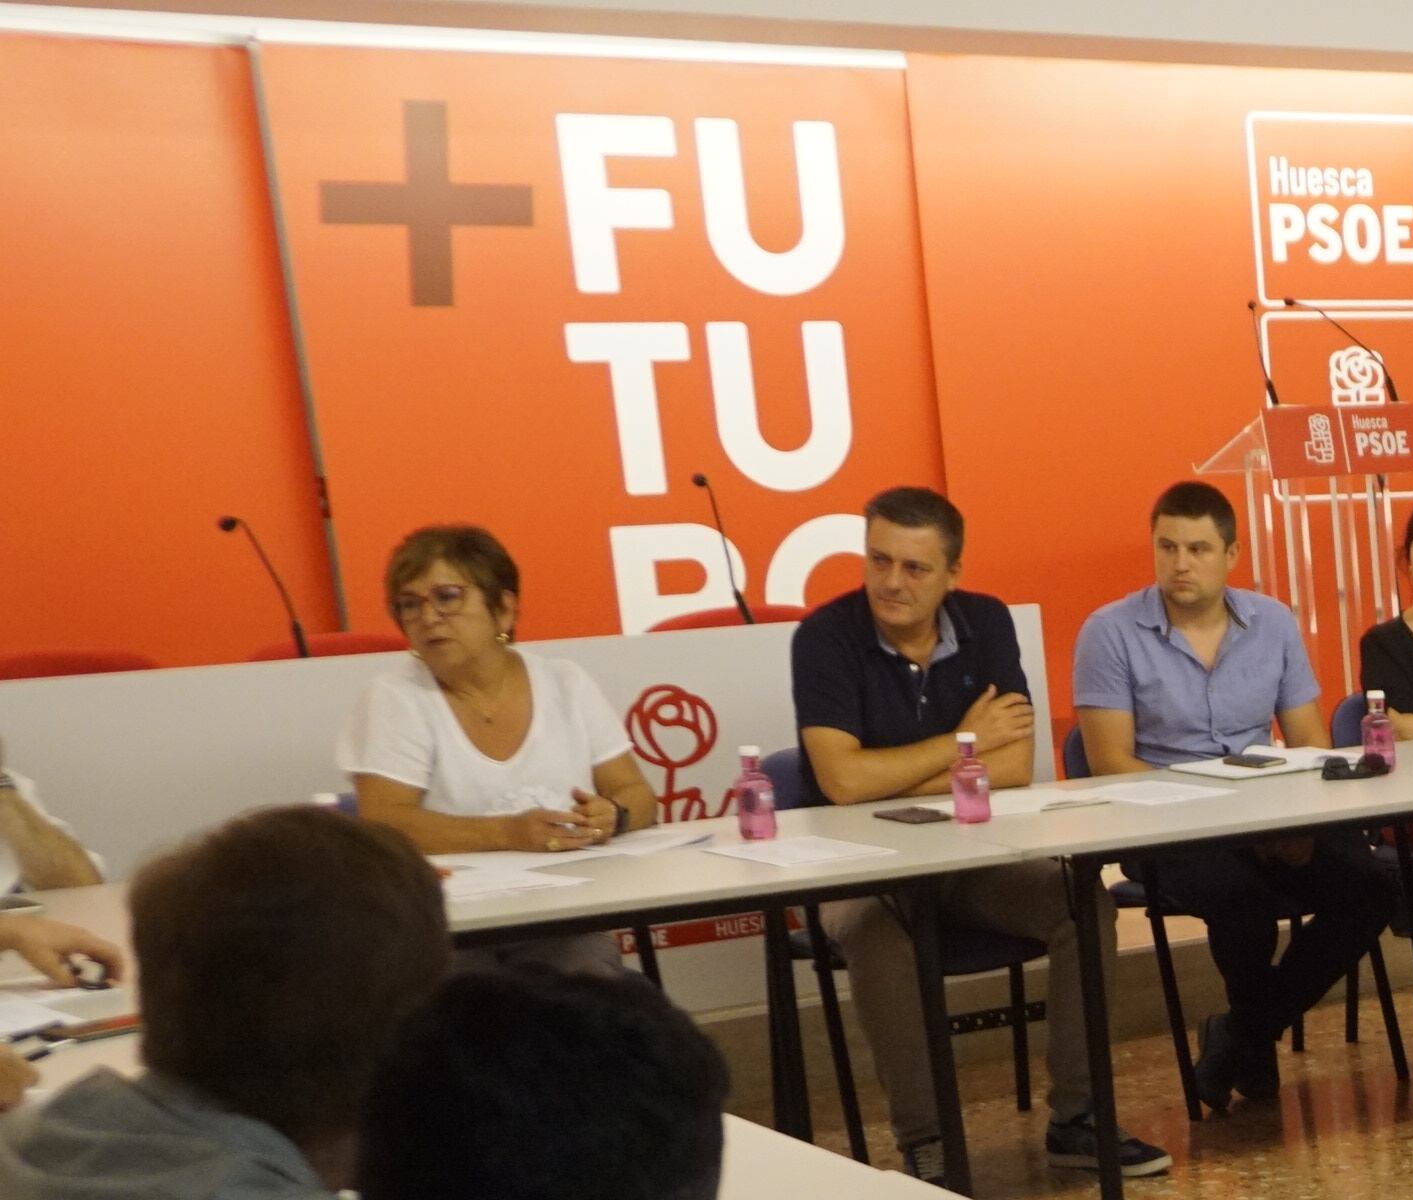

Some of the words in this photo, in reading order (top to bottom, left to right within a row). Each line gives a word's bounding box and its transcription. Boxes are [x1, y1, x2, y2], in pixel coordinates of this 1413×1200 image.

[1267, 155, 1374, 198] Huesca
[555, 113, 845, 296] FU
[564, 320, 853, 496] TU
[1351, 414, 1388, 430] Huesca
[1354, 430, 1410, 457] PSOE
[621, 929, 669, 953] PE
[715, 914, 766, 938] HUES
